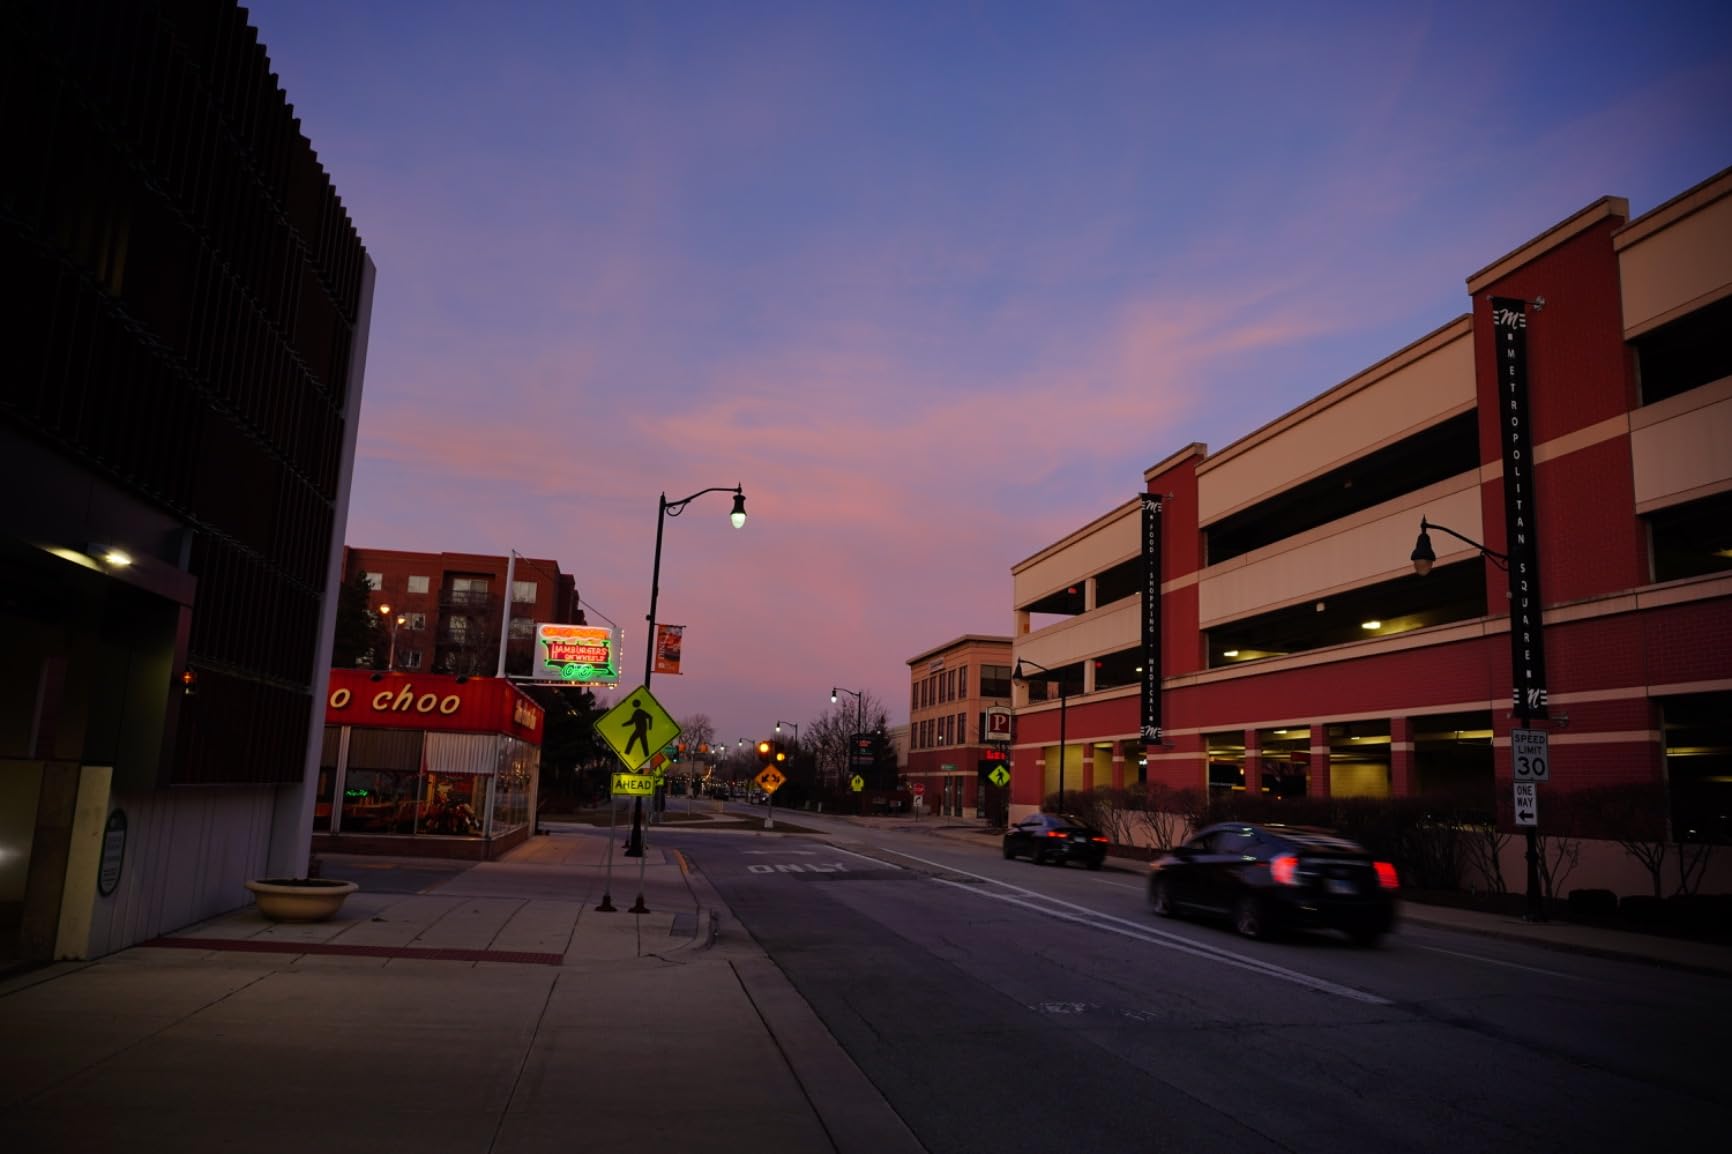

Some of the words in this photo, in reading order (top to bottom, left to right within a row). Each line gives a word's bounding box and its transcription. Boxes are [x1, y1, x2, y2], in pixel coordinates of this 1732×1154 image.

[1507, 348, 1526, 545] METROPOLITAN
[1519, 562, 1531, 661] SQUARE
[551, 643, 608, 657] HAMBURGERS
[372, 683, 460, 715] choo
[992, 714, 1006, 731] P
[1515, 734, 1545, 744] SPEED
[1518, 745, 1542, 754] LIMIT
[1518, 757, 1546, 776] 30
[615, 780, 651, 790] AHEAD
[1516, 786, 1532, 796] ONE
[1517, 798, 1533, 807] WAY
[747, 863, 848, 873] ONLY
